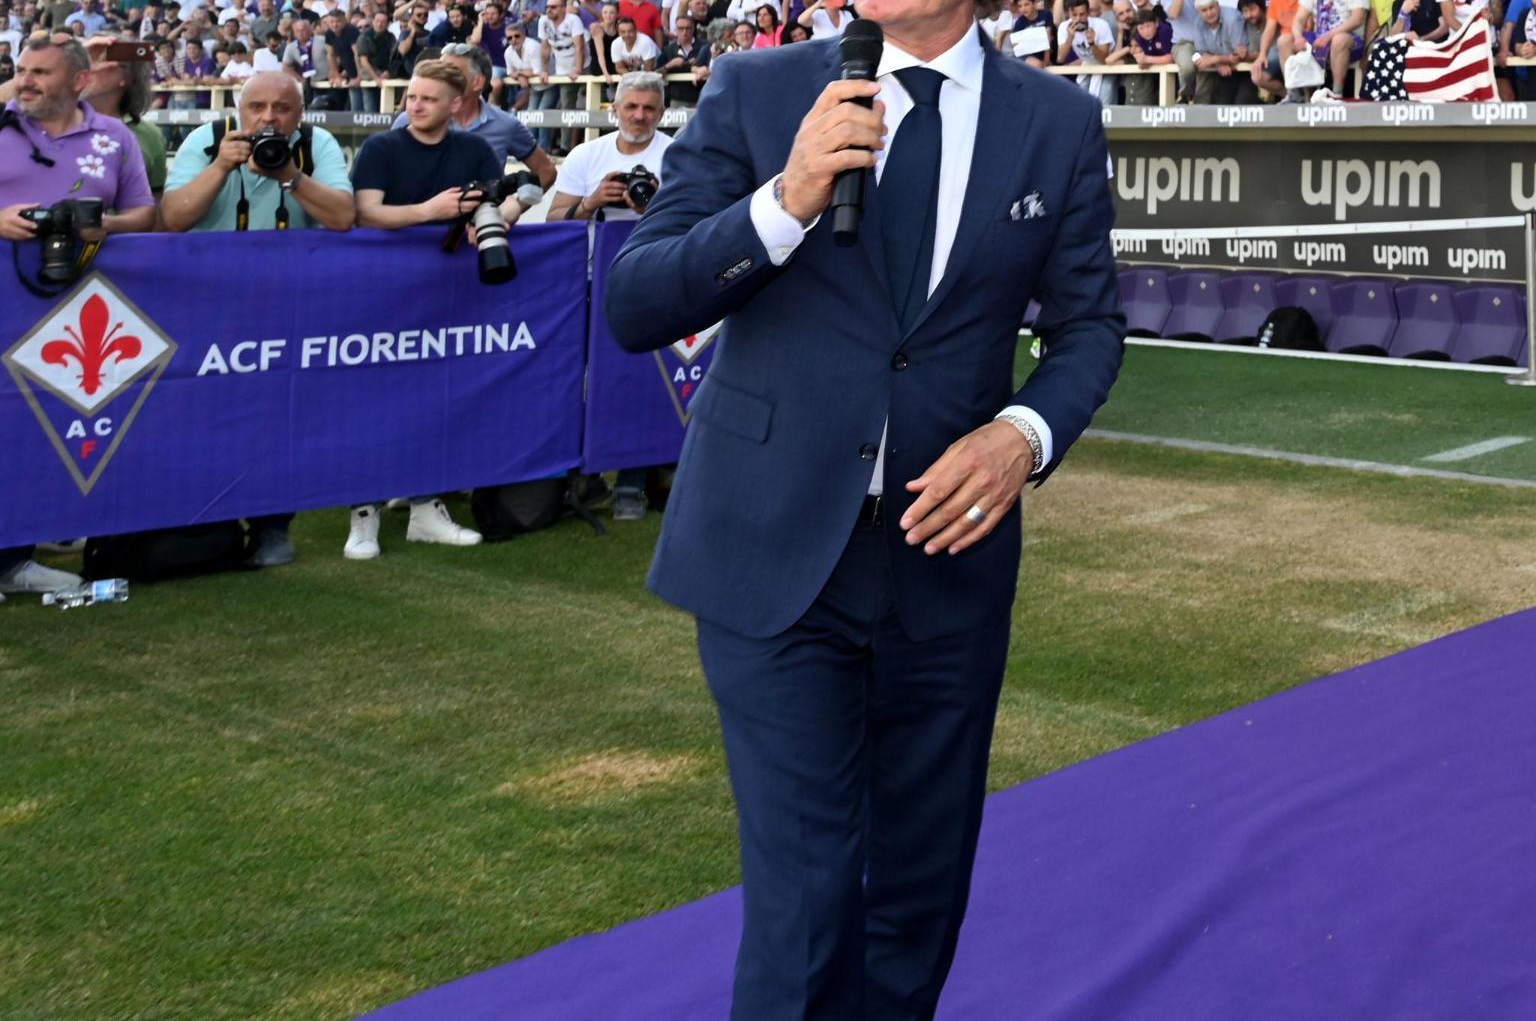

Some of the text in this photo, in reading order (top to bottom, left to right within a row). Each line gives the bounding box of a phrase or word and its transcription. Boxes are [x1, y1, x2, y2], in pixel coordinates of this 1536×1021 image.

[353, 114, 391, 128] upim
[561, 112, 589, 127] upim
[1142, 107, 1186, 127] upim
[1217, 107, 1265, 127] upim
[1297, 106, 1347, 127] upim
[1382, 102, 1435, 125] upim
[1471, 101, 1528, 125] upim
[1117, 156, 1240, 215] upim
[1301, 158, 1441, 221] upim
[1161, 236, 1210, 260] upim
[1226, 237, 1277, 263] upim
[1294, 240, 1346, 267] upim
[1373, 244, 1429, 271] upim
[1447, 245, 1506, 274] upim
[197, 321, 537, 377] ACF FIORENTINA
